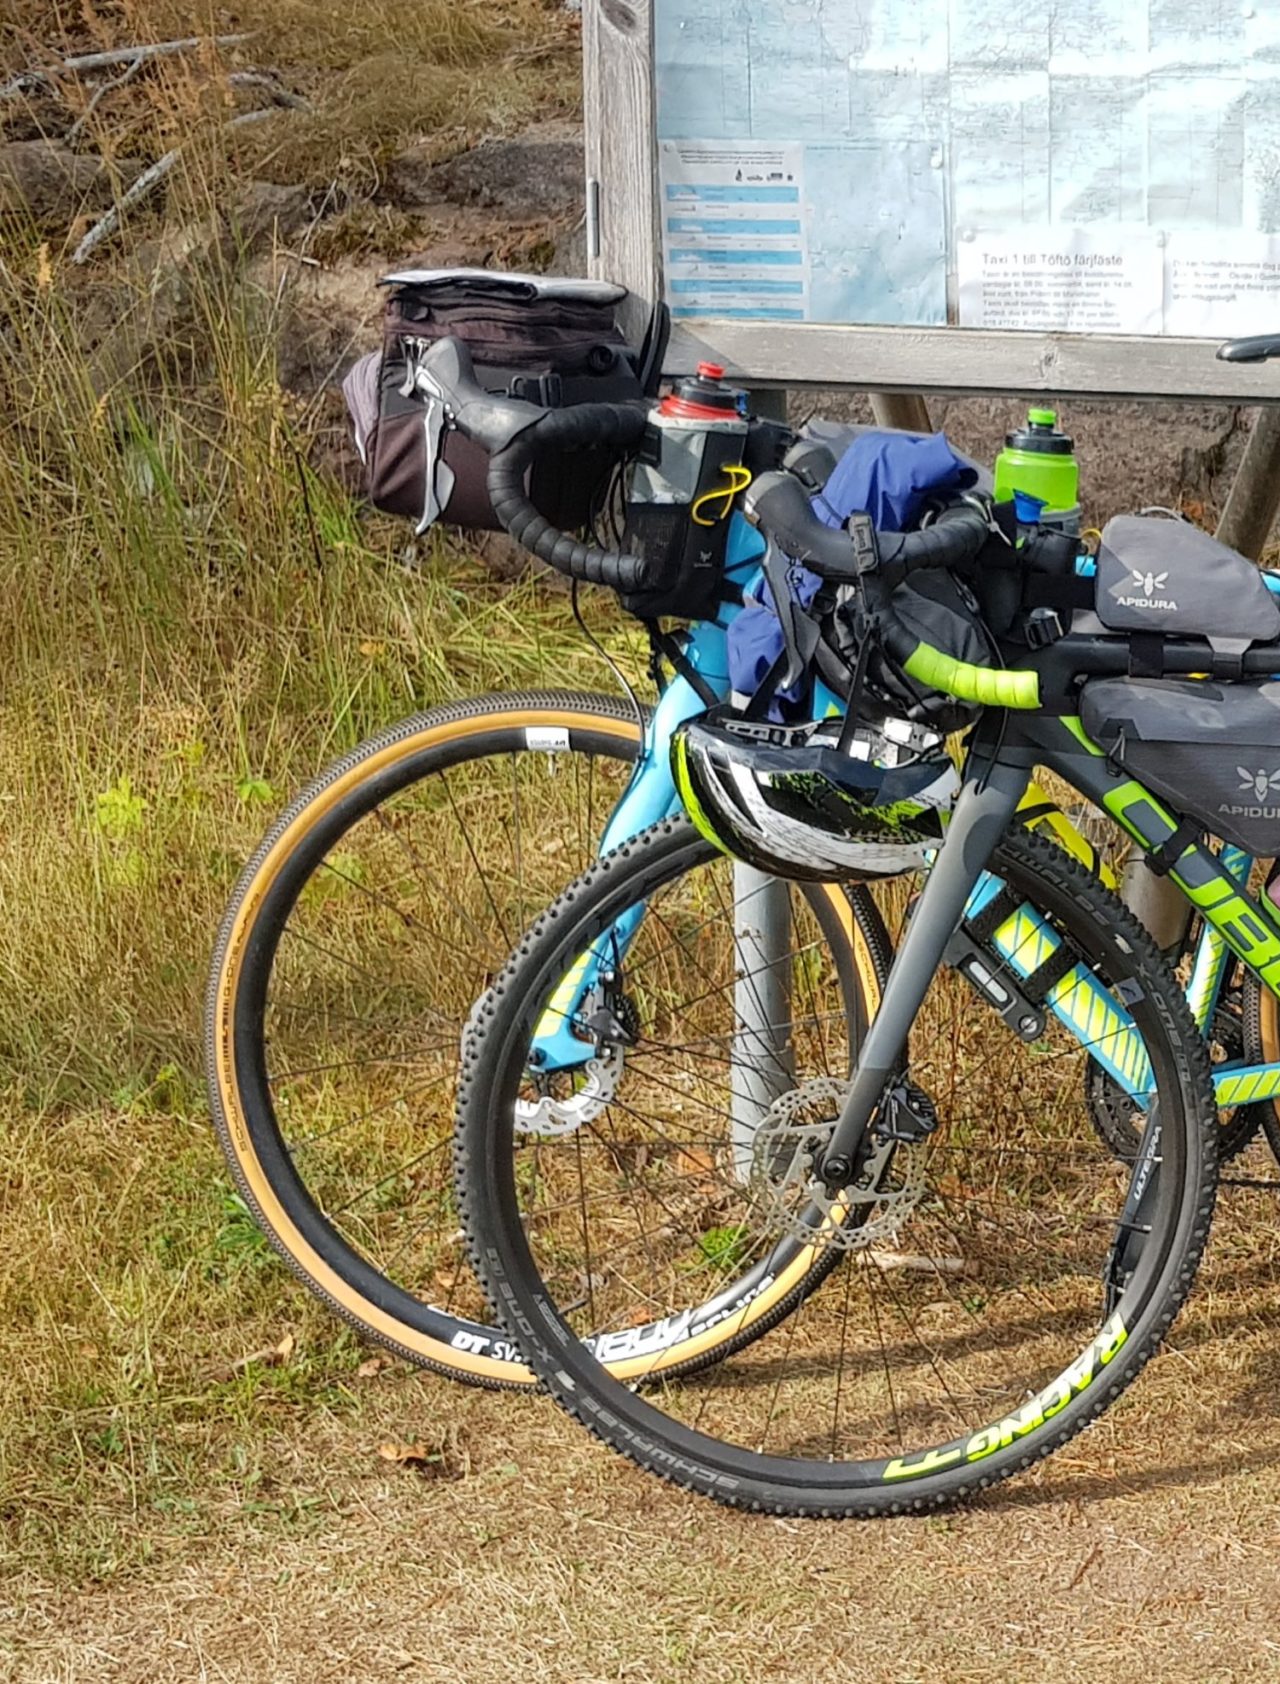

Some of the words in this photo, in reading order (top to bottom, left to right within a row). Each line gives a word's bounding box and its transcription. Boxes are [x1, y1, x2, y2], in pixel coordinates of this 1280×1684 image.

[981, 253, 1008, 265] Taxi
[1023, 253, 1037, 265] till
[1116, 595, 1178, 611] APIDURA
[451, 1329, 492, 1354] DT
[966, 1311, 1129, 1464] RACING
[583, 1396, 741, 1490] SCHWALBE
